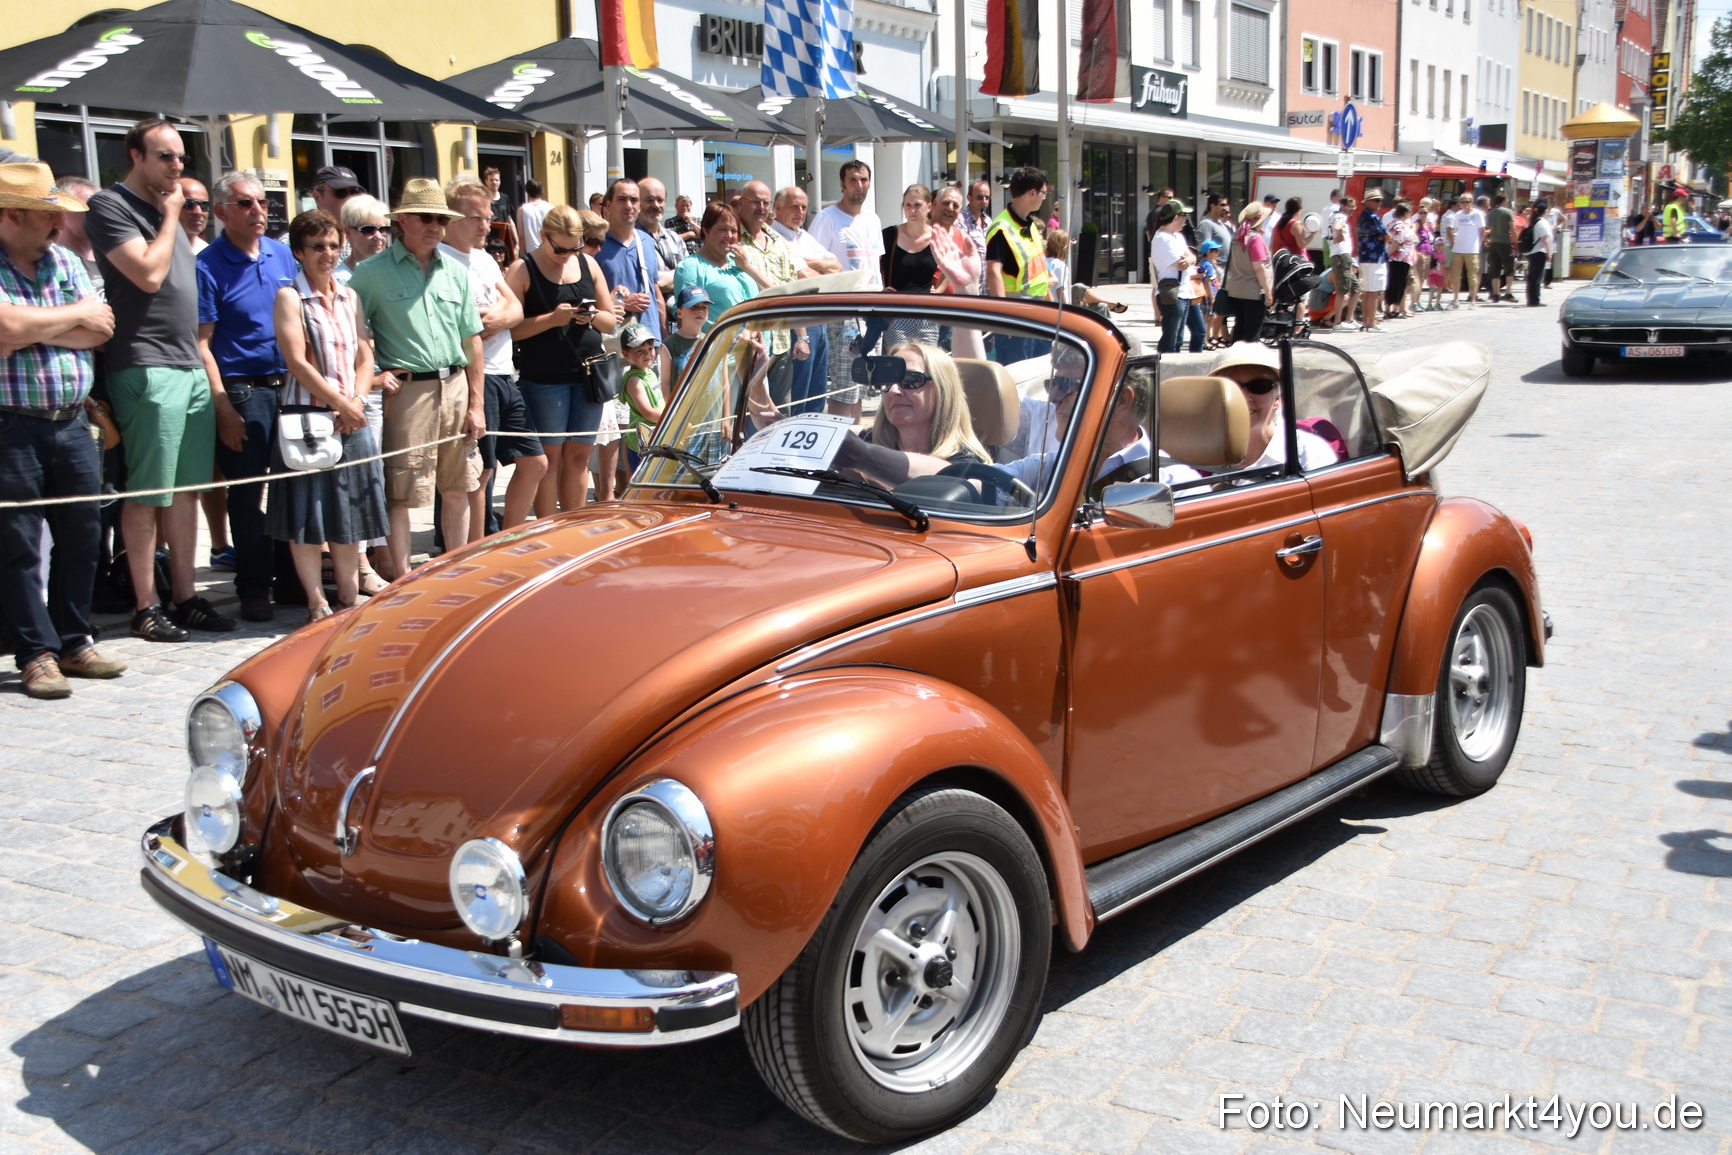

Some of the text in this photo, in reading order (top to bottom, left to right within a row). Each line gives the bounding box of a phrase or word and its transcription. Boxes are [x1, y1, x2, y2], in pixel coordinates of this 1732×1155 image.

[24, 28, 144, 88] now
[707, 16, 763, 60] BRILL
[248, 34, 375, 98] now
[1134, 71, 1188, 114] frühauf
[1651, 53, 1669, 124] HOTE
[550, 151, 562, 166] 24
[1628, 347, 1681, 357] AS 06103
[781, 430, 818, 450] 129
[311, 988, 403, 1048] 555H
